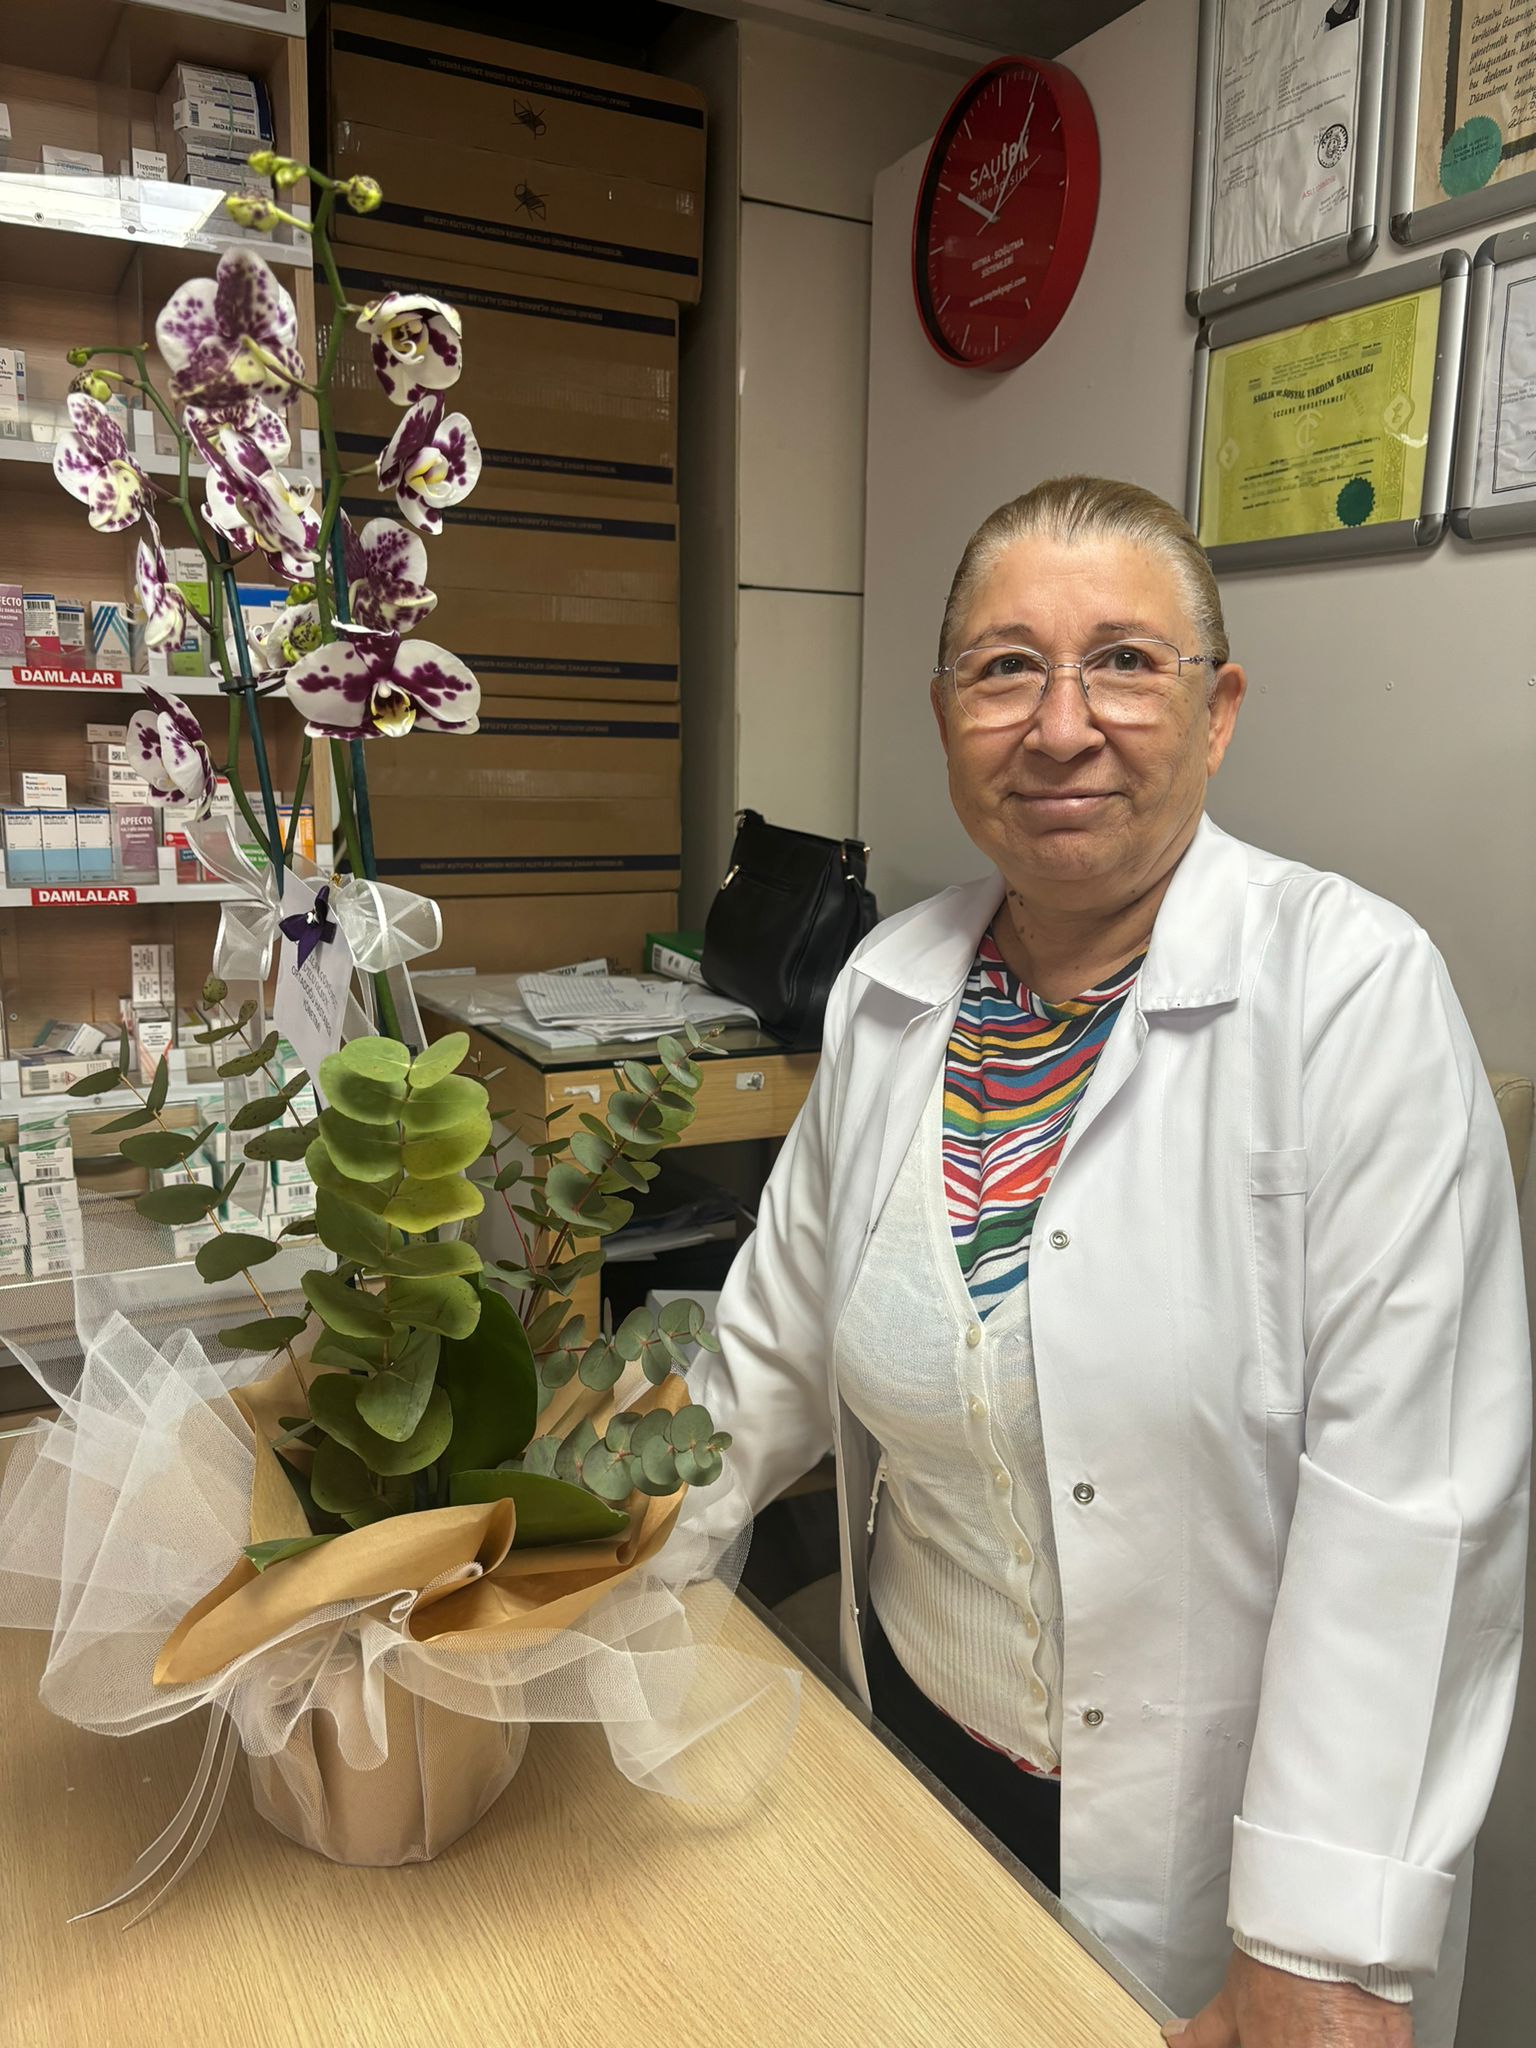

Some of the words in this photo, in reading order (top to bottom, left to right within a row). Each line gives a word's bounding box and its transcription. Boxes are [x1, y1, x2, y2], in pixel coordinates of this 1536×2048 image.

[1307, 379, 1335, 399] YARDIM
[1336, 363, 1374, 385] BAKANLIĞI
[20, 669, 116, 685] DAMLALAR
[38, 890, 130, 903] DAMLALAR
